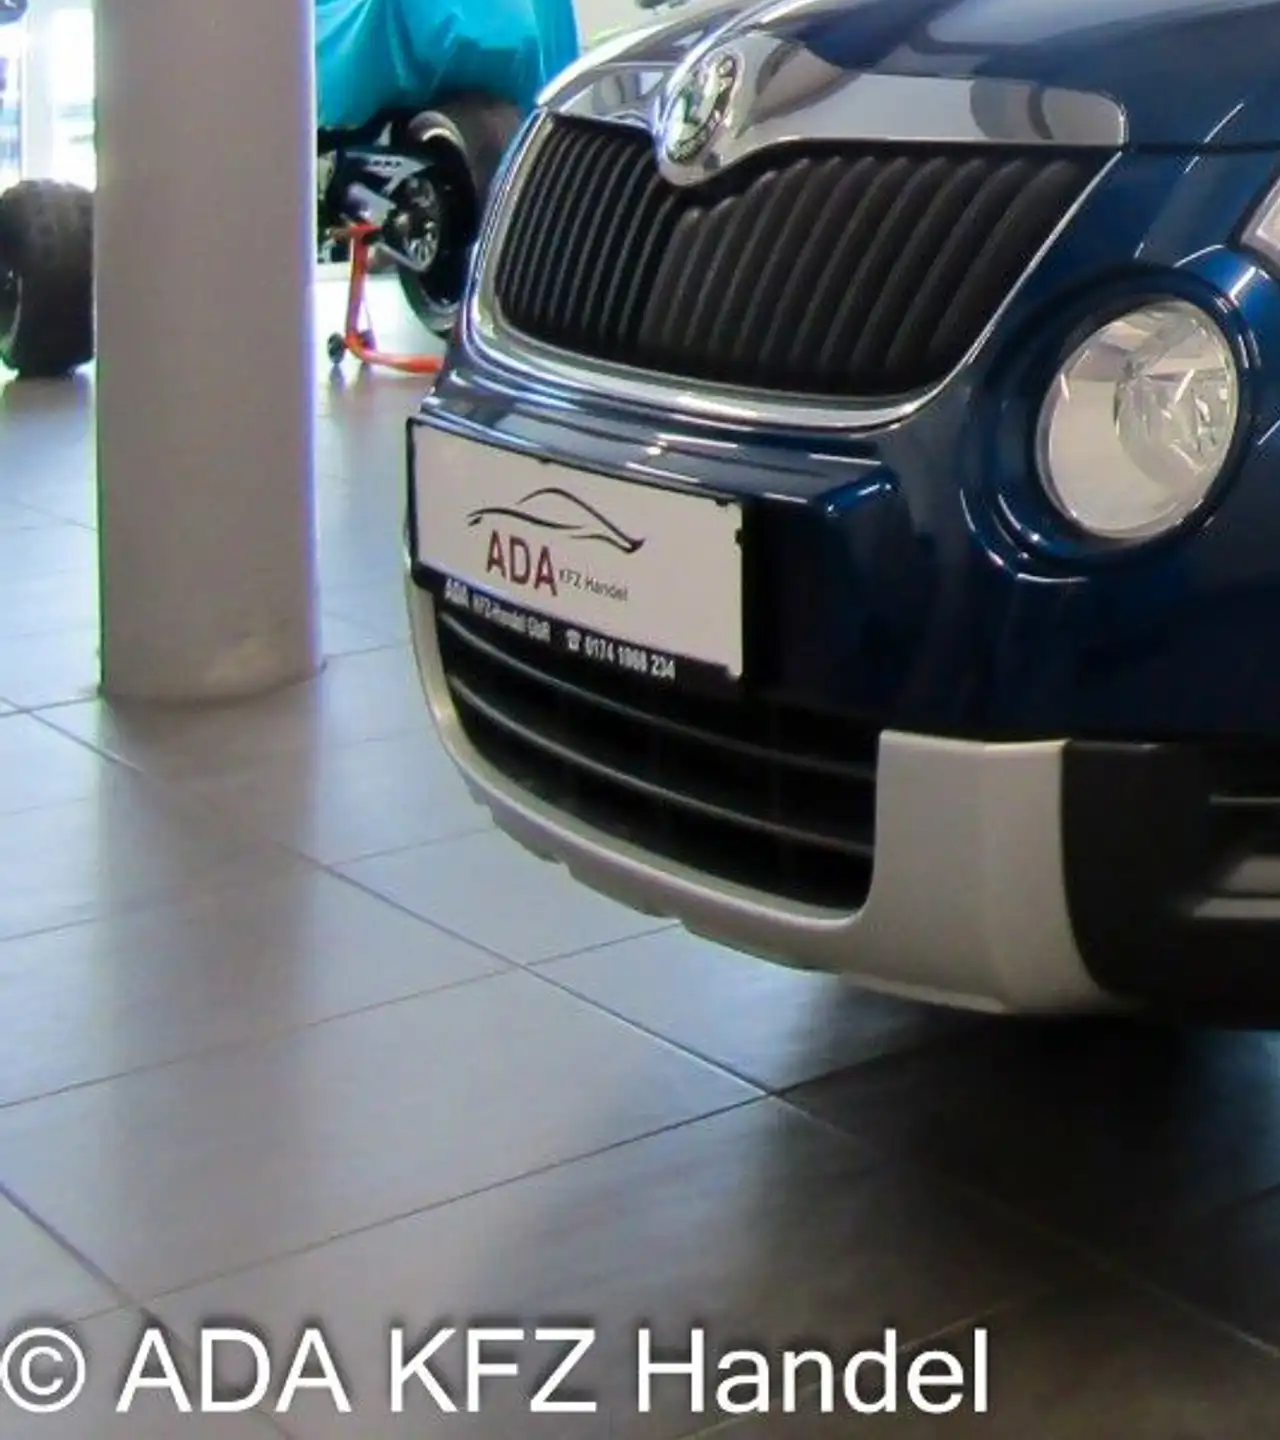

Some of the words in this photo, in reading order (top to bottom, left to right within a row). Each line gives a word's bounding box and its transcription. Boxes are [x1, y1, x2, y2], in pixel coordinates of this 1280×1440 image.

[487, 530, 558, 597] ADA
[559, 568, 582, 591] KFZ
[584, 576, 629, 602] Handel
[585, 636, 615, 664] 0174
